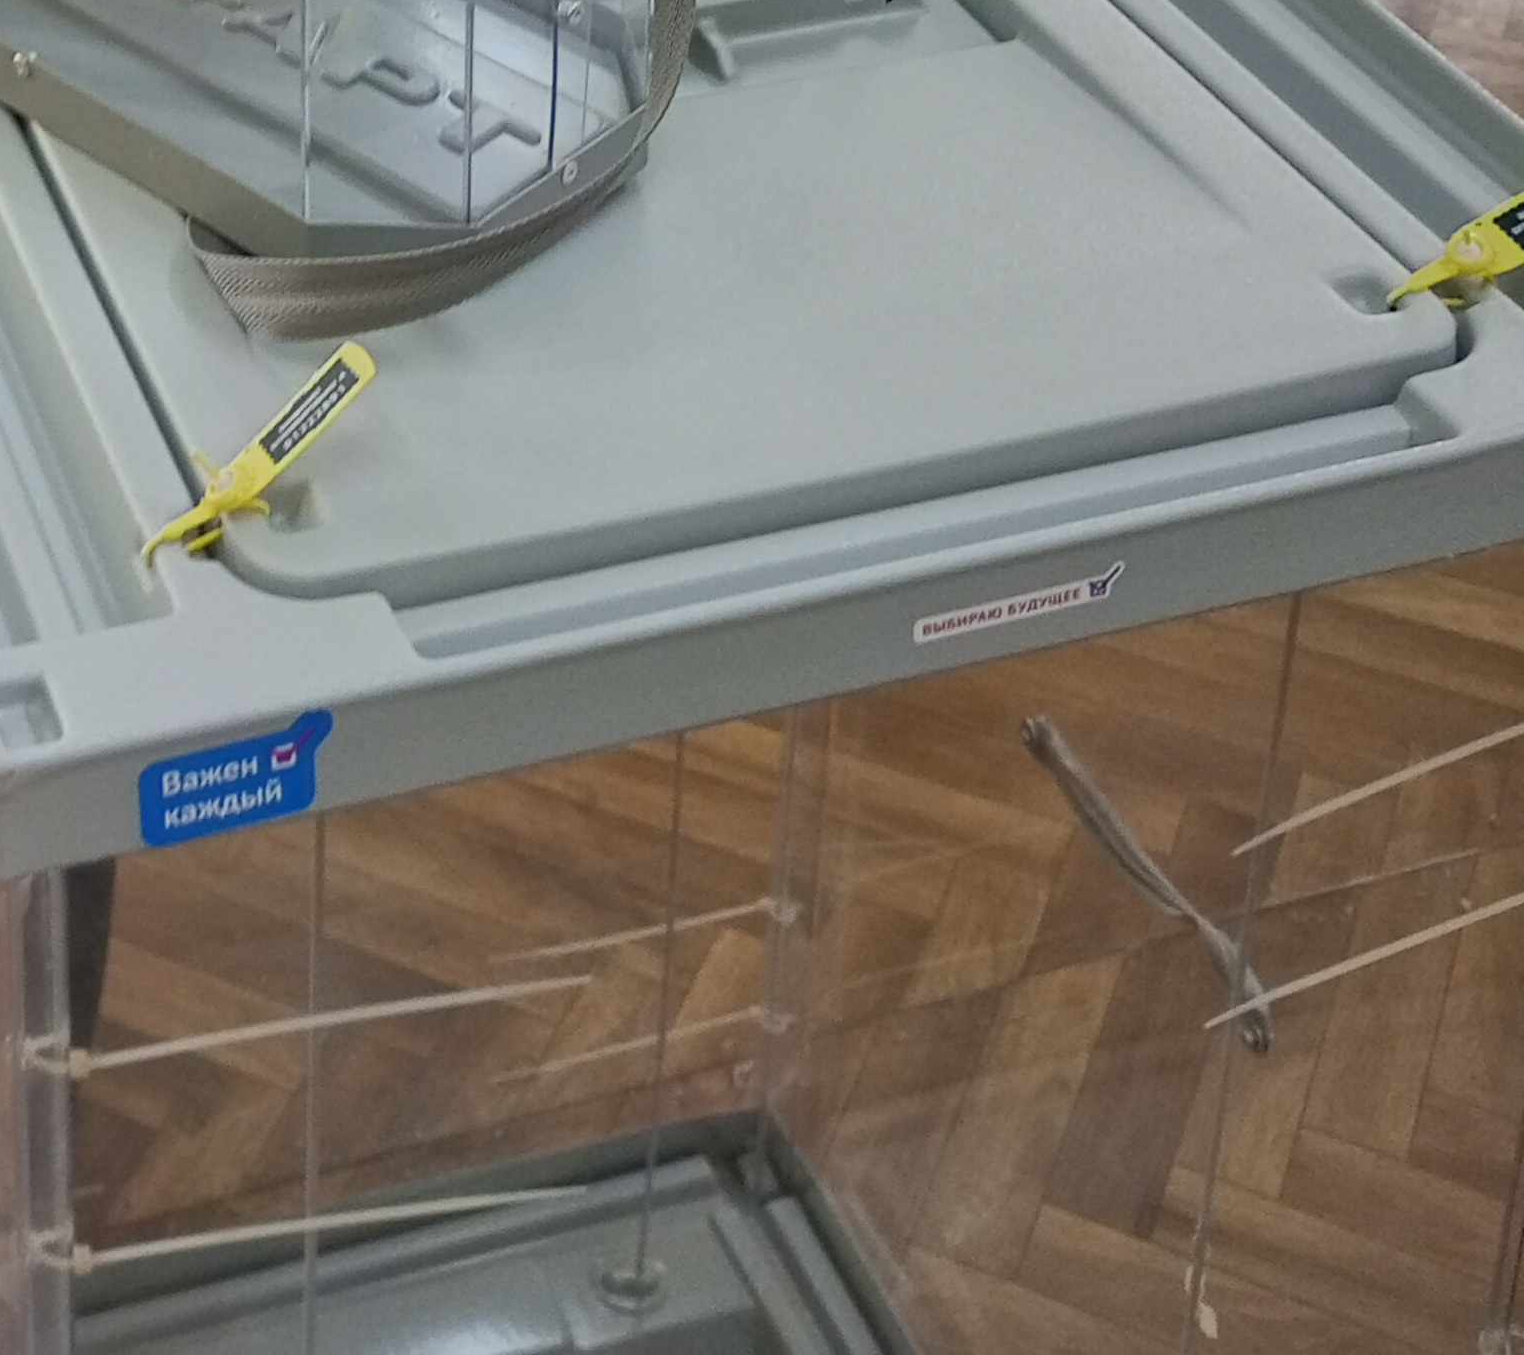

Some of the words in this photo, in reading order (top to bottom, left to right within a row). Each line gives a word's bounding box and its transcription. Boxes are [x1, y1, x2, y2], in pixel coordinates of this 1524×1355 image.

[922, 608, 1003, 636] ВЫБИРАЮ
[1007, 587, 1083, 617] БУДУЩЕЕ
[161, 754, 259, 799] Важен
[163, 775, 283, 830] каждый
